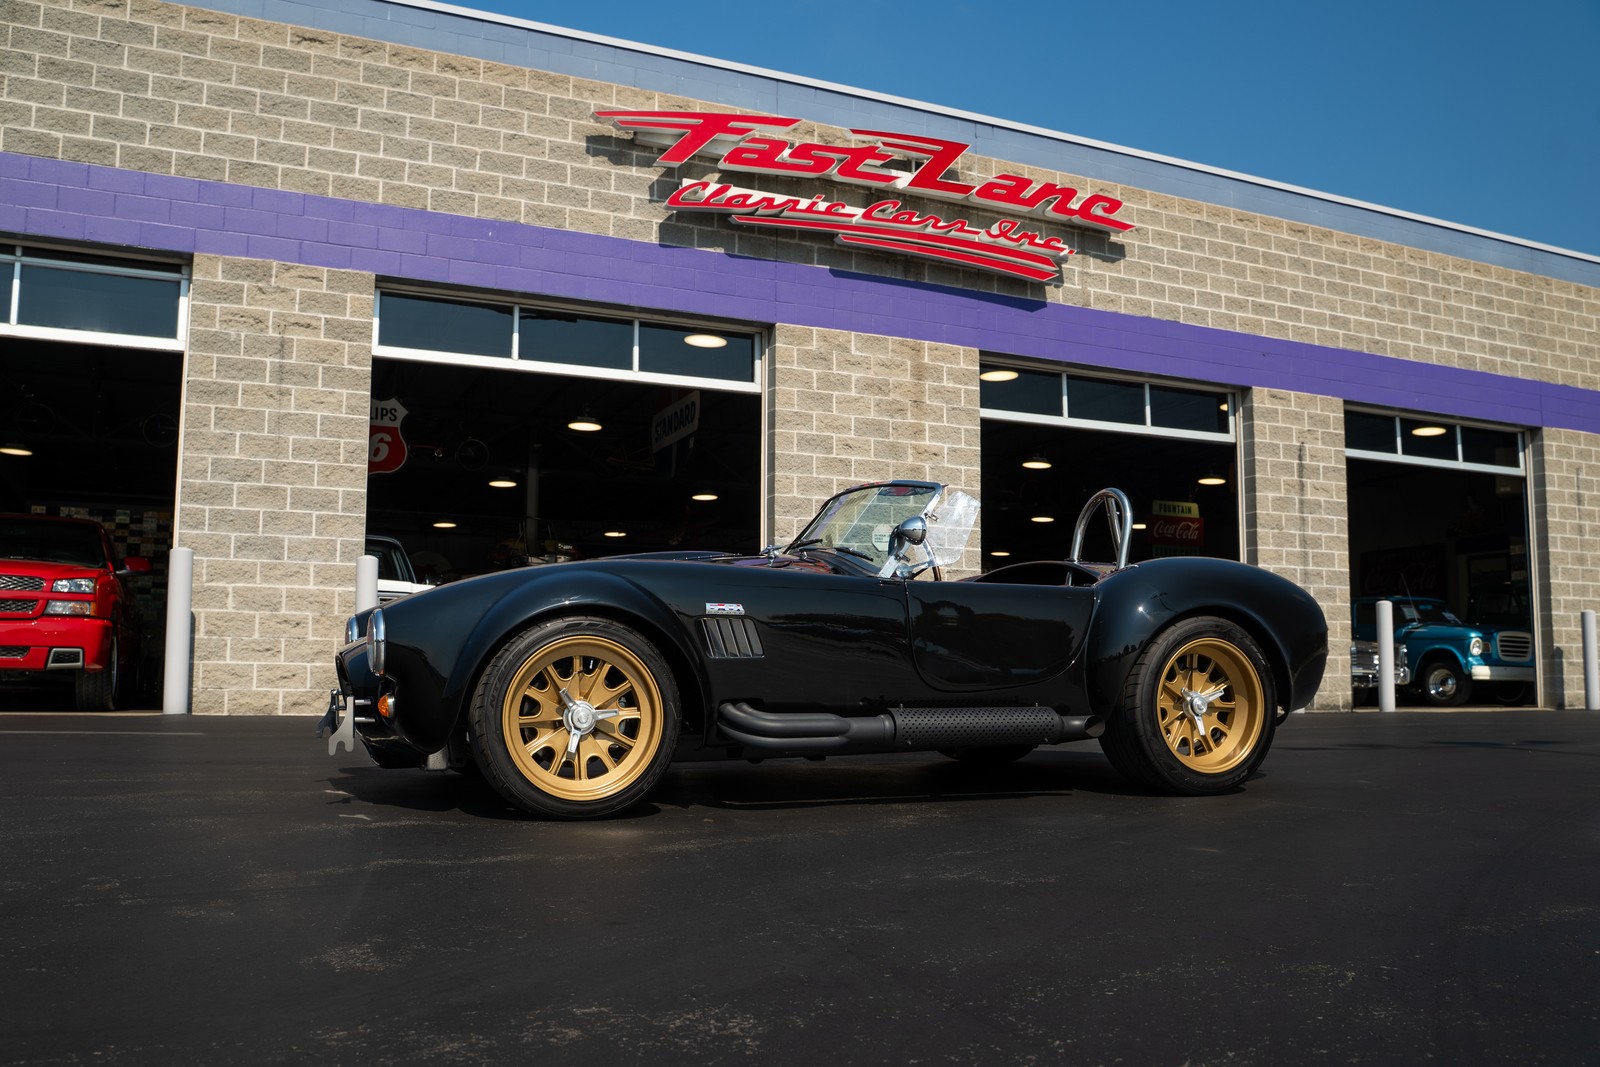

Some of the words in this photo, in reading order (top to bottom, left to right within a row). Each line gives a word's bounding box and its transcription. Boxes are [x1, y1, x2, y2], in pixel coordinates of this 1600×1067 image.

[593, 110, 902, 185] Fast
[850, 128, 1137, 232] Lane
[666, 181, 858, 219] Classic
[860, 200, 982, 236] Cars
[985, 219, 1077, 256] Inc.
[655, 401, 696, 443] STANDARD
[1159, 503, 1192, 515] FOUNTAIN
